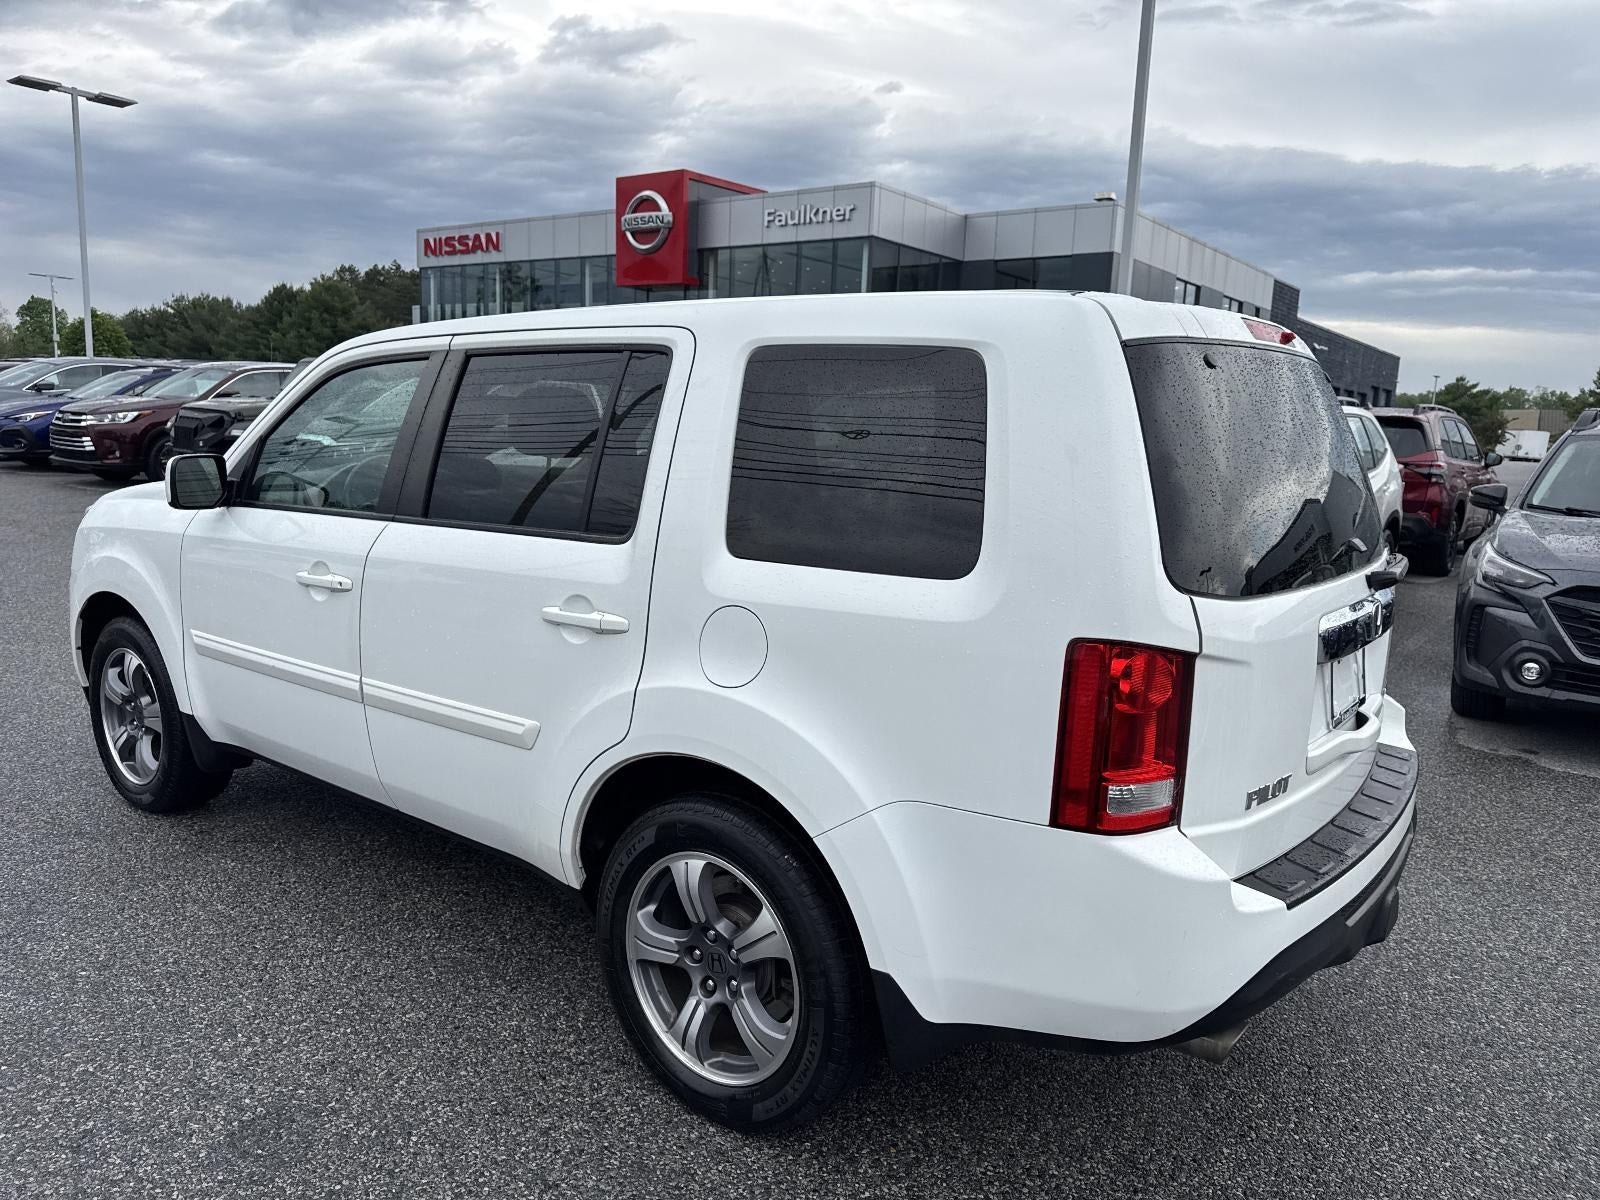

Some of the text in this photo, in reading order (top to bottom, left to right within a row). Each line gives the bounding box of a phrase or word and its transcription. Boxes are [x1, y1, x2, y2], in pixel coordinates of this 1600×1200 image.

[623, 215, 665, 228] NISSAN
[764, 203, 855, 228] Faulkner
[424, 231, 501, 257] NISSAN
[1245, 773, 1292, 810] PILOT
